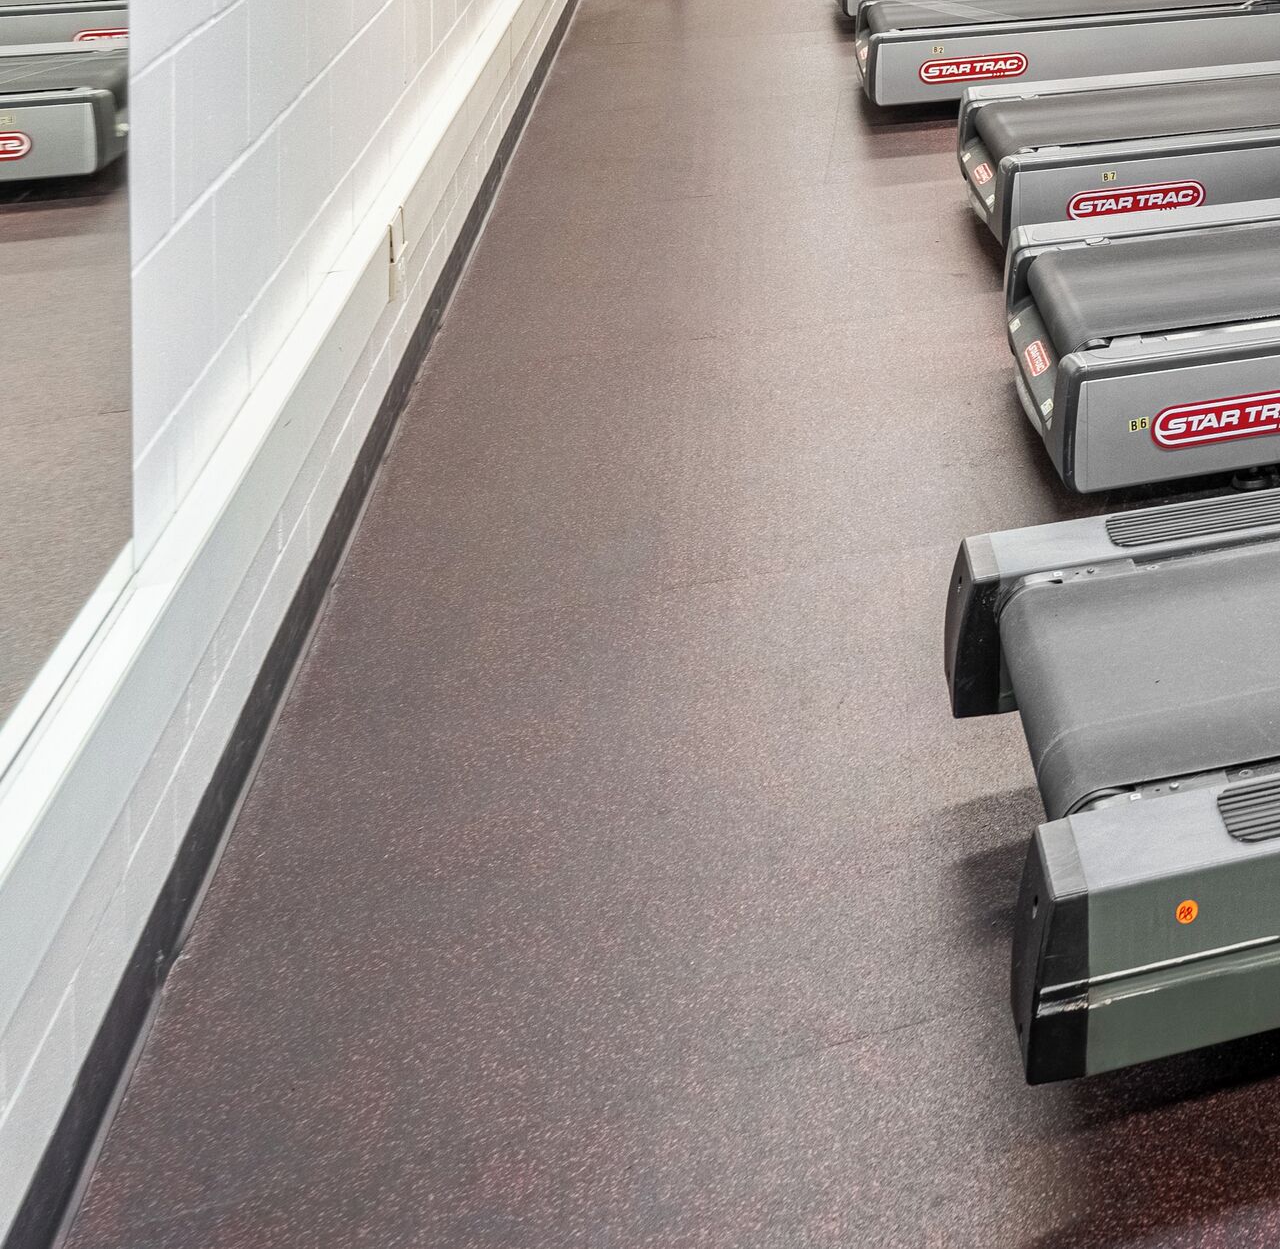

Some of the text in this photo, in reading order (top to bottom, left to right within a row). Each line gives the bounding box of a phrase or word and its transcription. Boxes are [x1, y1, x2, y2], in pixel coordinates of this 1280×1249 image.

[928, 59, 1018, 75] STAR TRAC
[1078, 189, 1194, 214] STAR TRAC
[1168, 408, 1240, 434] STAR
